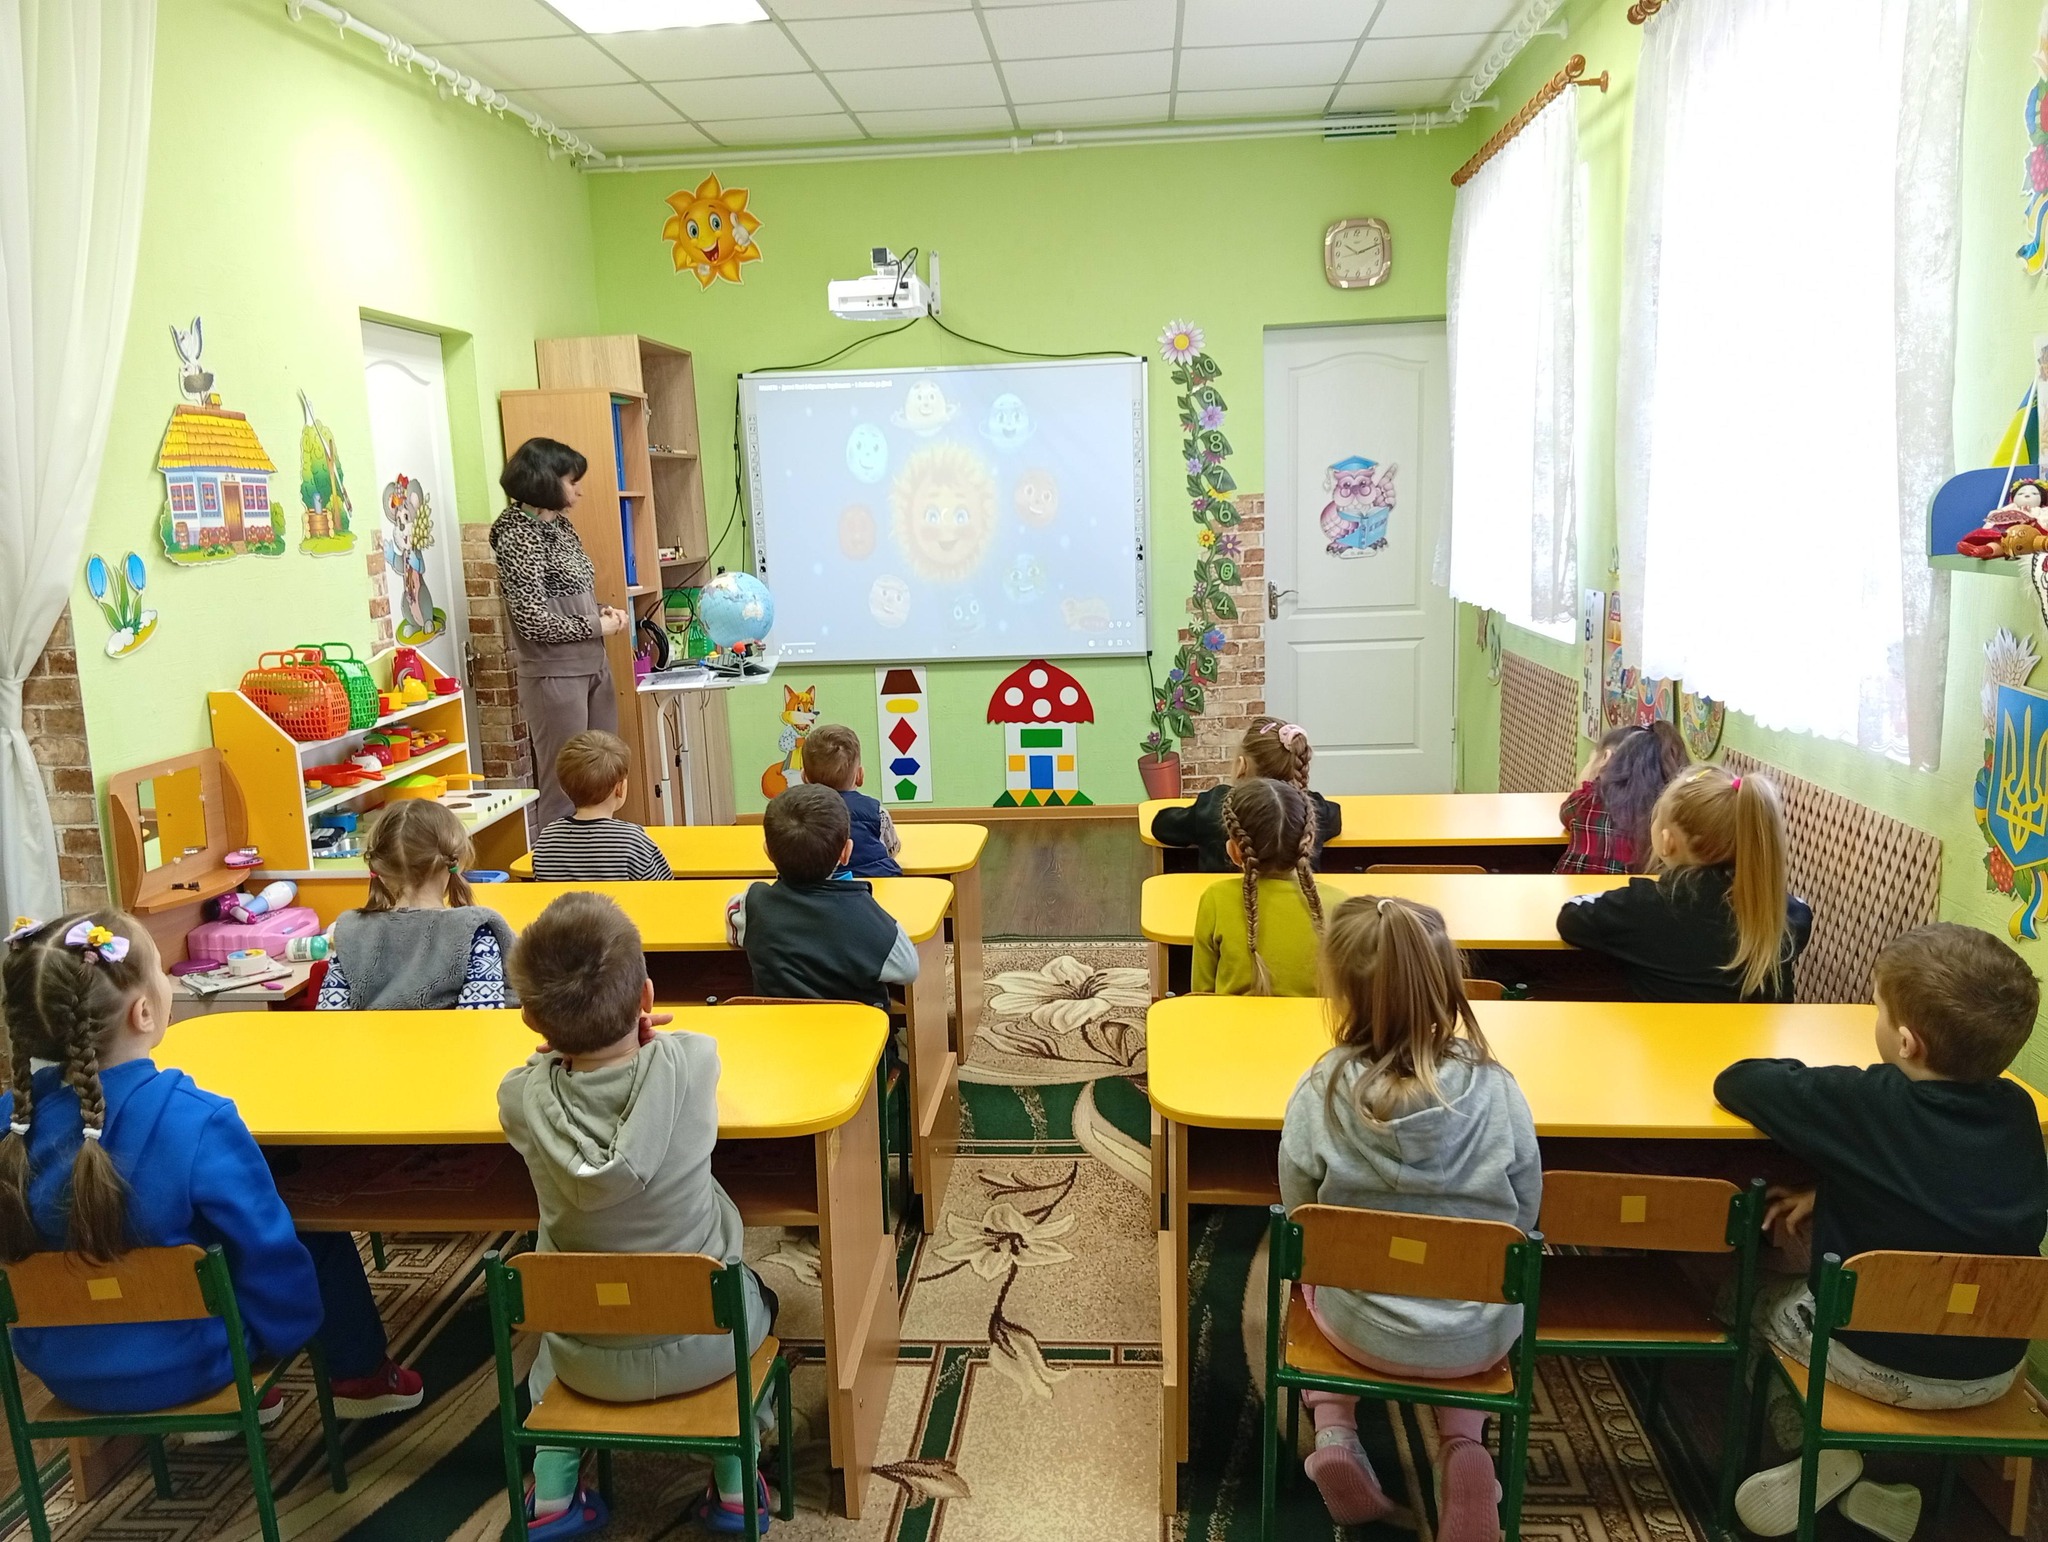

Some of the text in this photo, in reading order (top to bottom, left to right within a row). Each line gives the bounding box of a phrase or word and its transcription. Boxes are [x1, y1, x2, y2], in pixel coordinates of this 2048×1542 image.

[1196, 358, 1216, 377] 10
[1203, 390, 1216, 407] 9
[1210, 434, 1222, 453] 8
[1212, 469, 1224, 488] 7
[1219, 504, 1231, 522] 6
[1217, 597, 1229, 614] 4
[1200, 657, 1214, 674] 3
[1185, 687, 1200, 705] 2
[1178, 715, 1184, 732] 1
